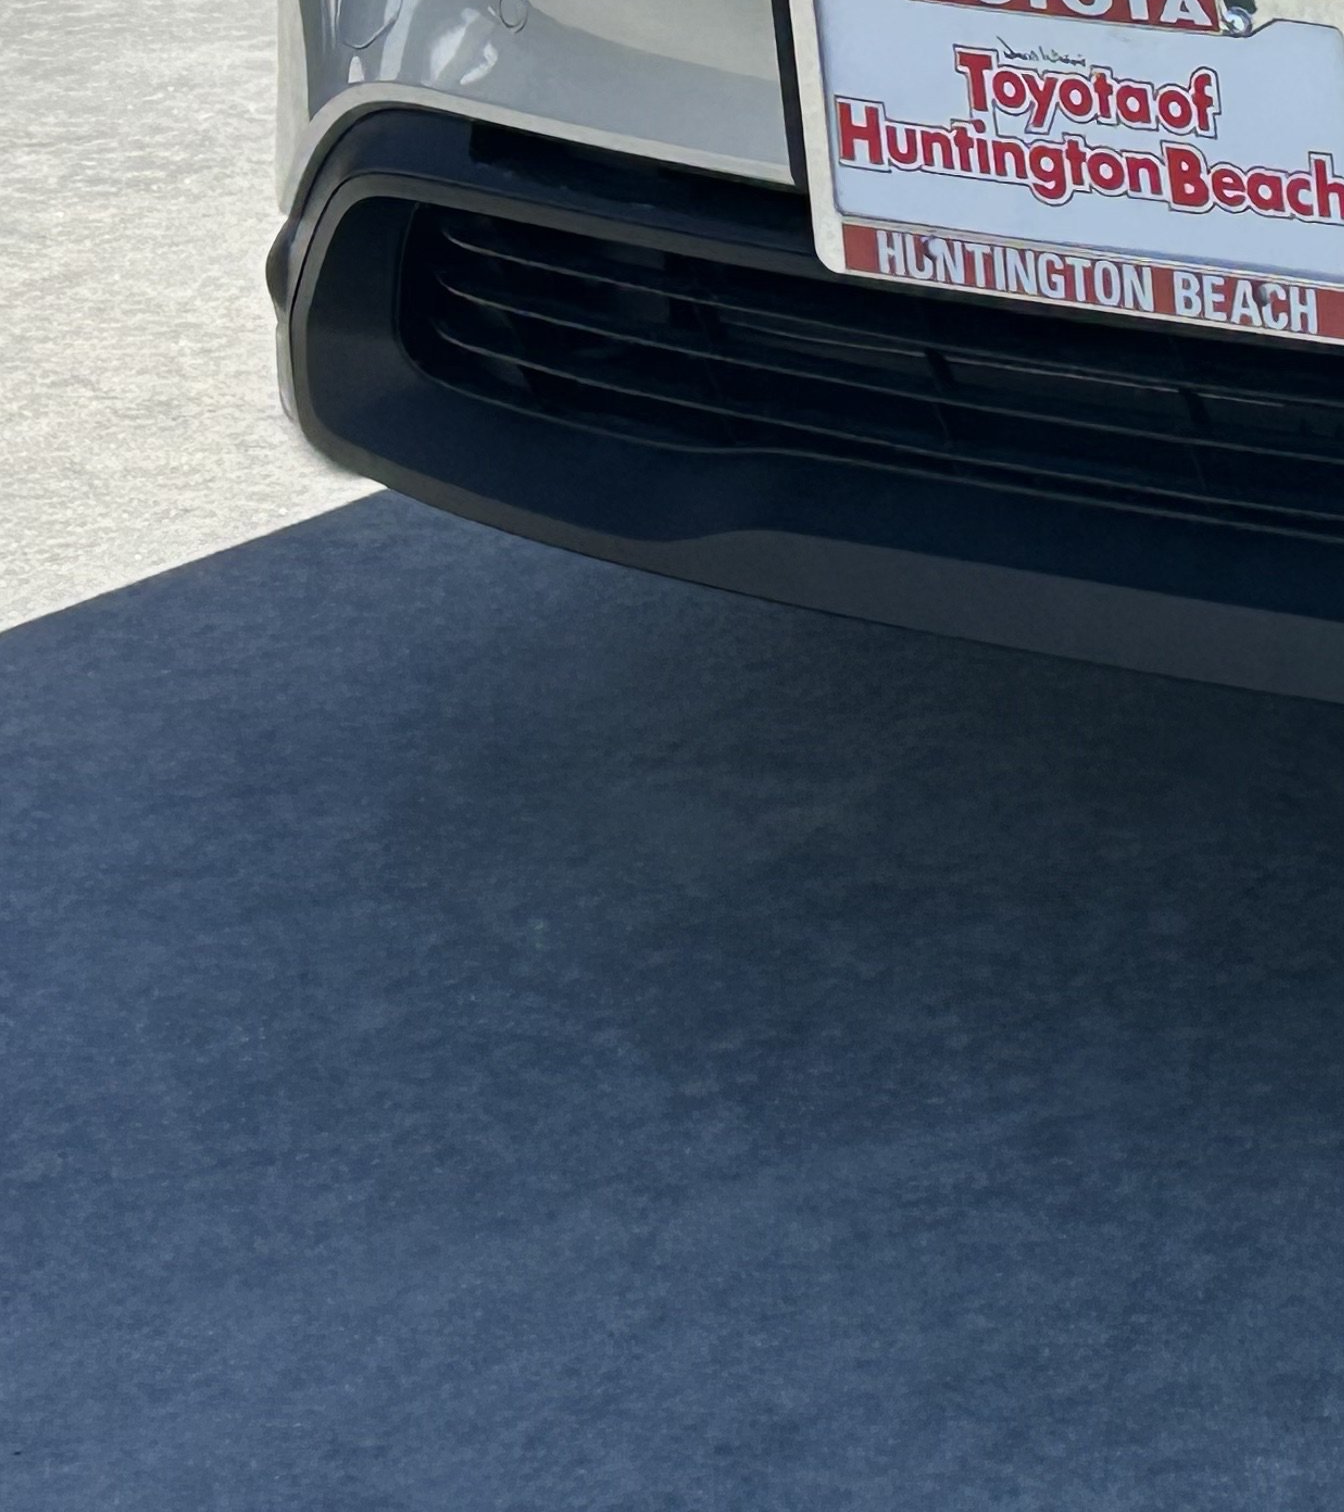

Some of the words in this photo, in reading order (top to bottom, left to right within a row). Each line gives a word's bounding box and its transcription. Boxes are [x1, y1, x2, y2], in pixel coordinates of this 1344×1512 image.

[836, 100, 1164, 201] Huntington
[875, 229, 1156, 314] HUNTINGTON
[1171, 270, 1320, 335] BEACH
